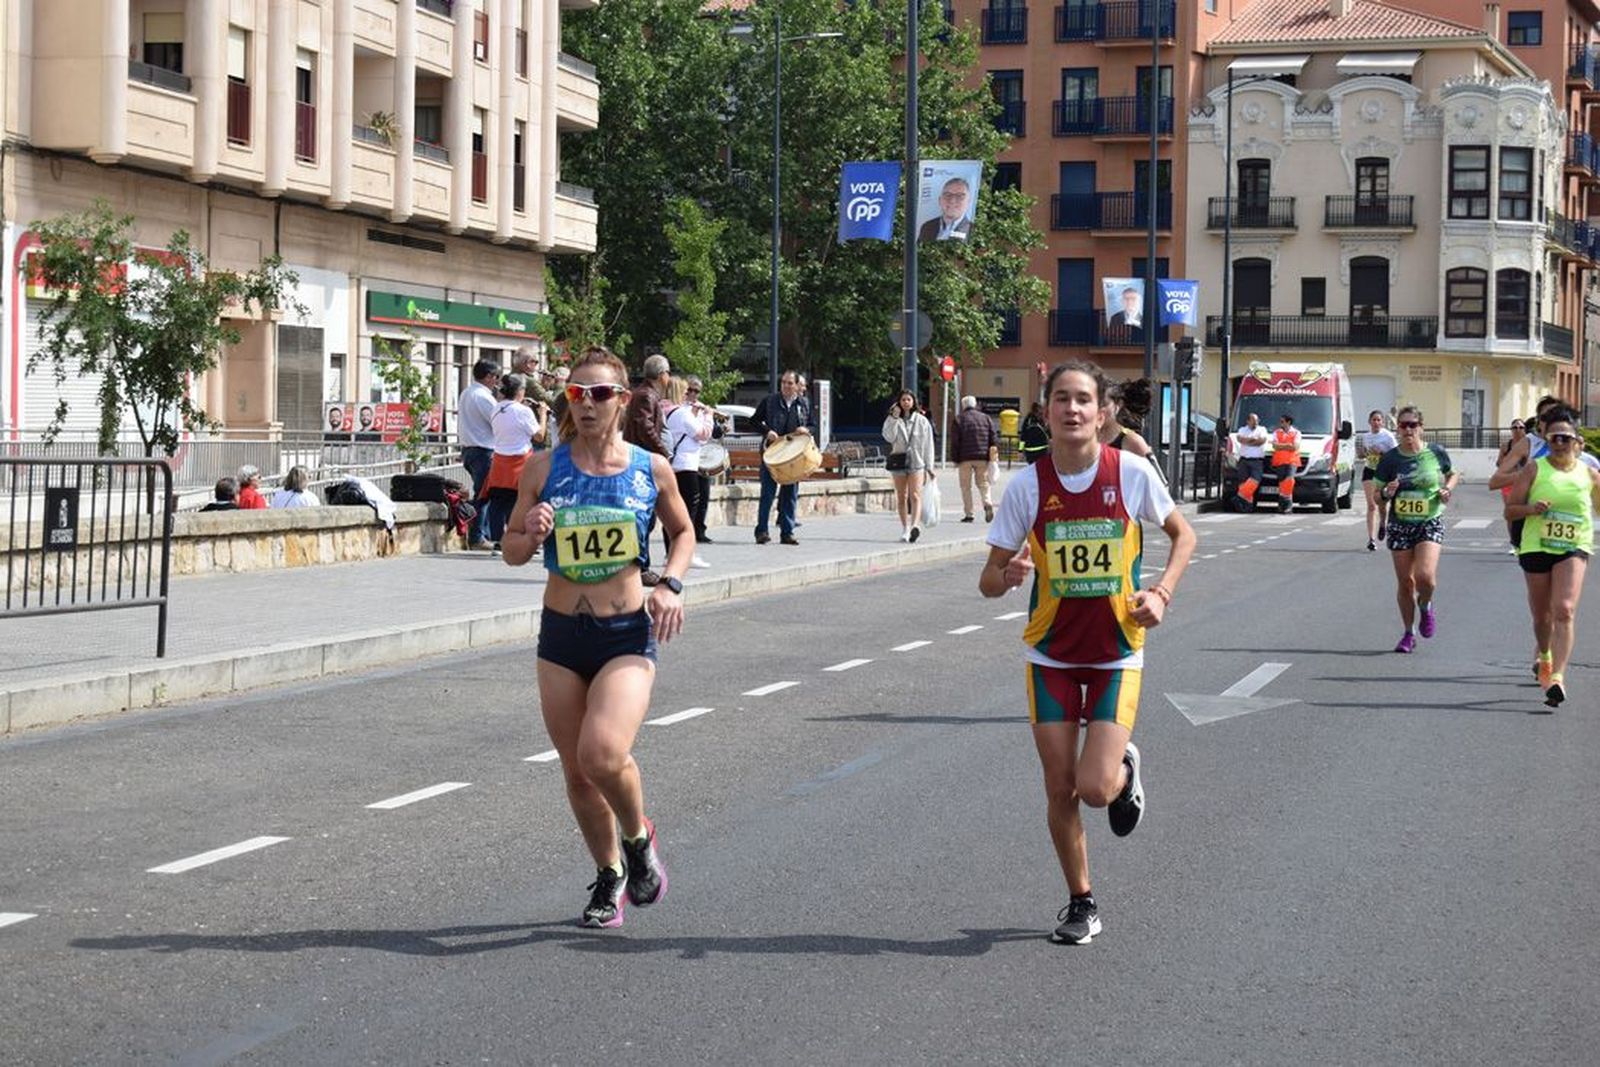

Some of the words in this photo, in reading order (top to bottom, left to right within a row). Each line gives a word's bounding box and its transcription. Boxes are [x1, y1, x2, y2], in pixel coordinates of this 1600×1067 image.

[850, 182, 885, 194] VOTA
[1165, 290, 1190, 299] VOTA
[1399, 500, 1423, 513] 216
[1545, 522, 1576, 540] 133
[565, 527, 626, 561] 142
[1054, 543, 1112, 574] 184
[582, 567, 605, 577] CAJA
[1069, 583, 1090, 592] CAJA
